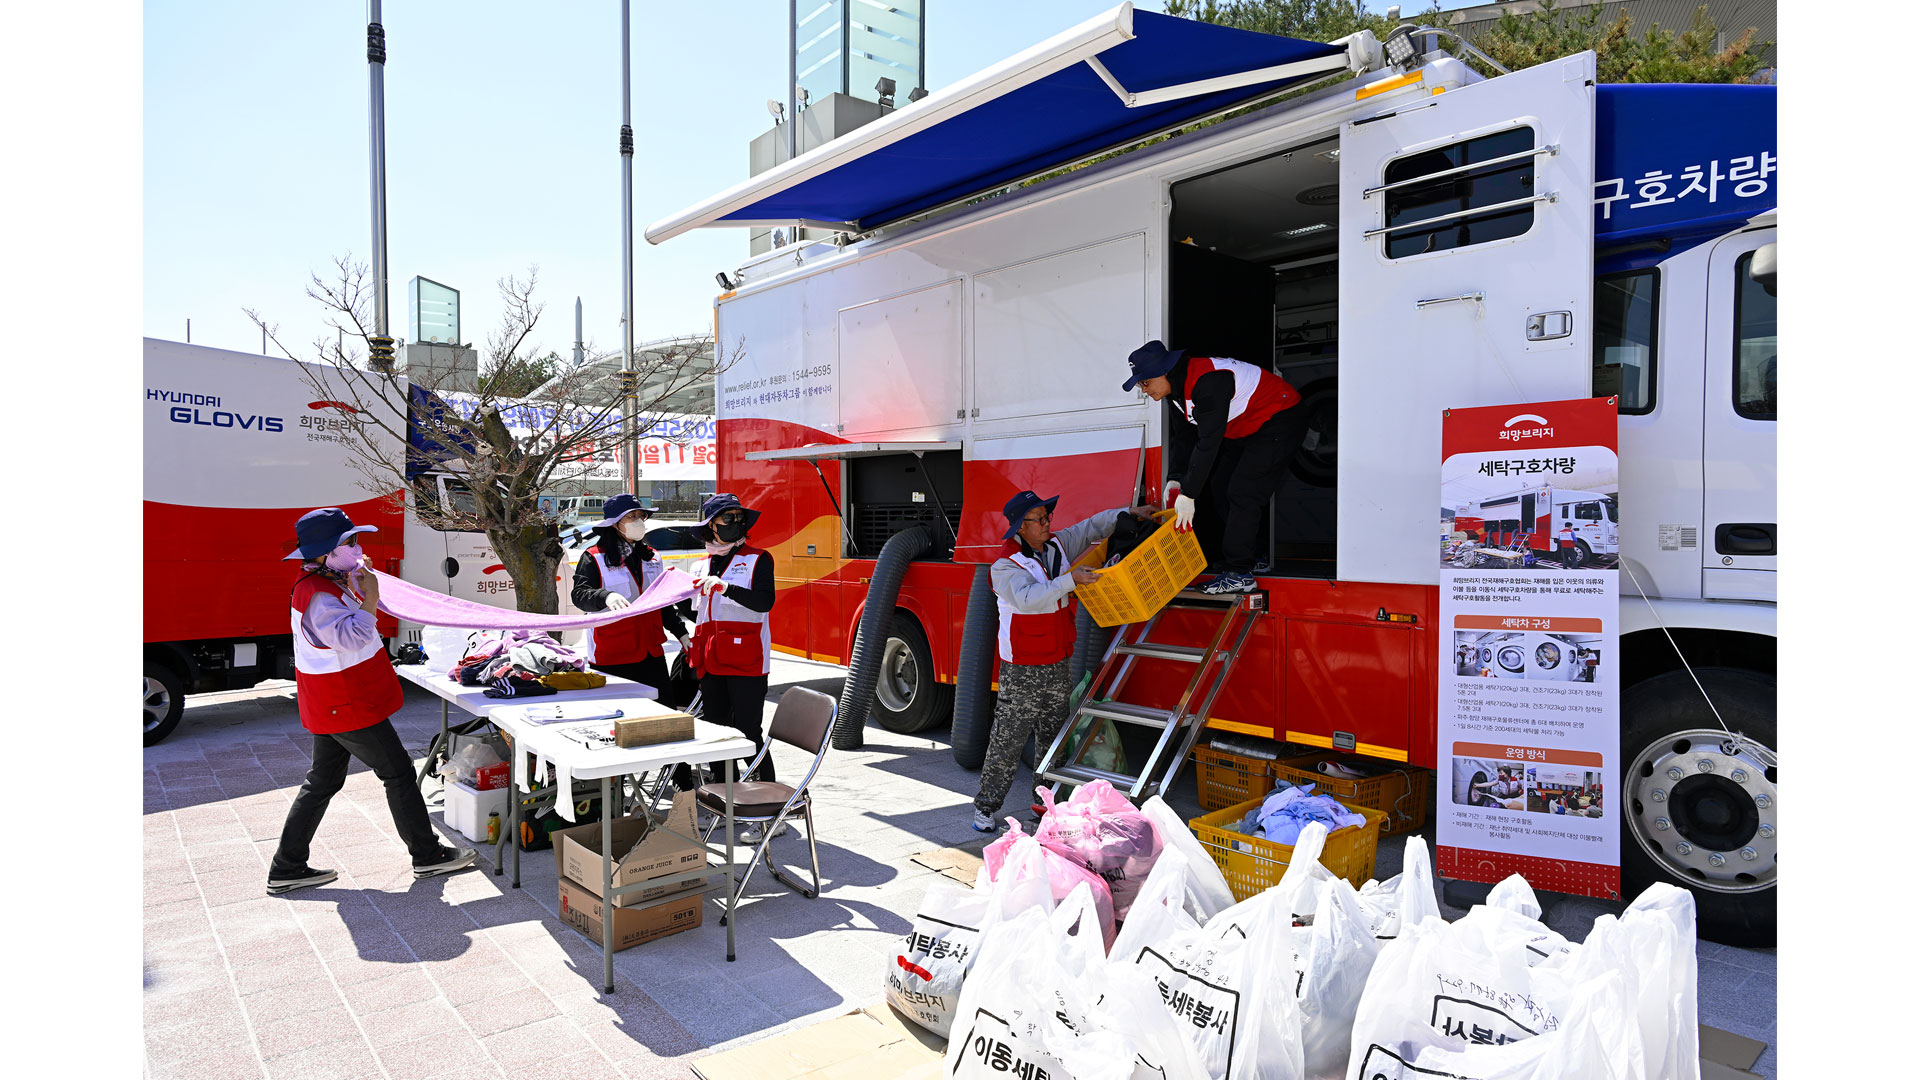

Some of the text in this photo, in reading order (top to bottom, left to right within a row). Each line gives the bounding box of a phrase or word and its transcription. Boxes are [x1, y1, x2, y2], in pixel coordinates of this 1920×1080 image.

[1594, 151, 1777, 219] 구호차량
[724, 378, 767, 394] www.relief.or.kr
[792, 364, 832, 381] 1544-9595
[147, 388, 221, 407] HYUNDAI
[725, 396, 752, 410] 희망브리지
[759, 387, 801, 405] 현대자동차그룹
[808, 384, 832, 397] 함께합니다
[170, 406, 284, 433] GLOVIS
[1499, 427, 1554, 441] 희망브리지
[1478, 457, 1576, 477] 세탁구호차량
[1481, 577, 1532, 585] 전국재해구호협회는
[1501, 618, 1551, 629] 세탁차 구성
[1485, 684, 1519, 693] 세탁기(20kg)
[1532, 687, 1567, 696] 건조기(23kg)
[1568, 688, 1584, 696] 3대가
[1458, 698, 1484, 706] 대형산업용
[1485, 699, 1519, 708] 세탁기(20kg)
[1532, 703, 1567, 712] 건조기(23kg)
[1568, 704, 1584, 712] 3대가
[1481, 715, 1530, 724] 재해구호물류센터에
[1549, 720, 1571, 728] 배치하여
[1494, 725, 1522, 733] 200세대의
[1523, 727, 1539, 735] 세탁물
[1505, 747, 1546, 760] 운영 방식
[1511, 817, 1532, 825] 구호활동
[1473, 822, 1485, 830] 기간
[1501, 826, 1523, 834] 취약세대
[1531, 829, 1566, 838] 사회복지단체
[1489, 831, 1511, 839] 봉사활동
[629, 860, 673, 875] ORANGE JUICE
